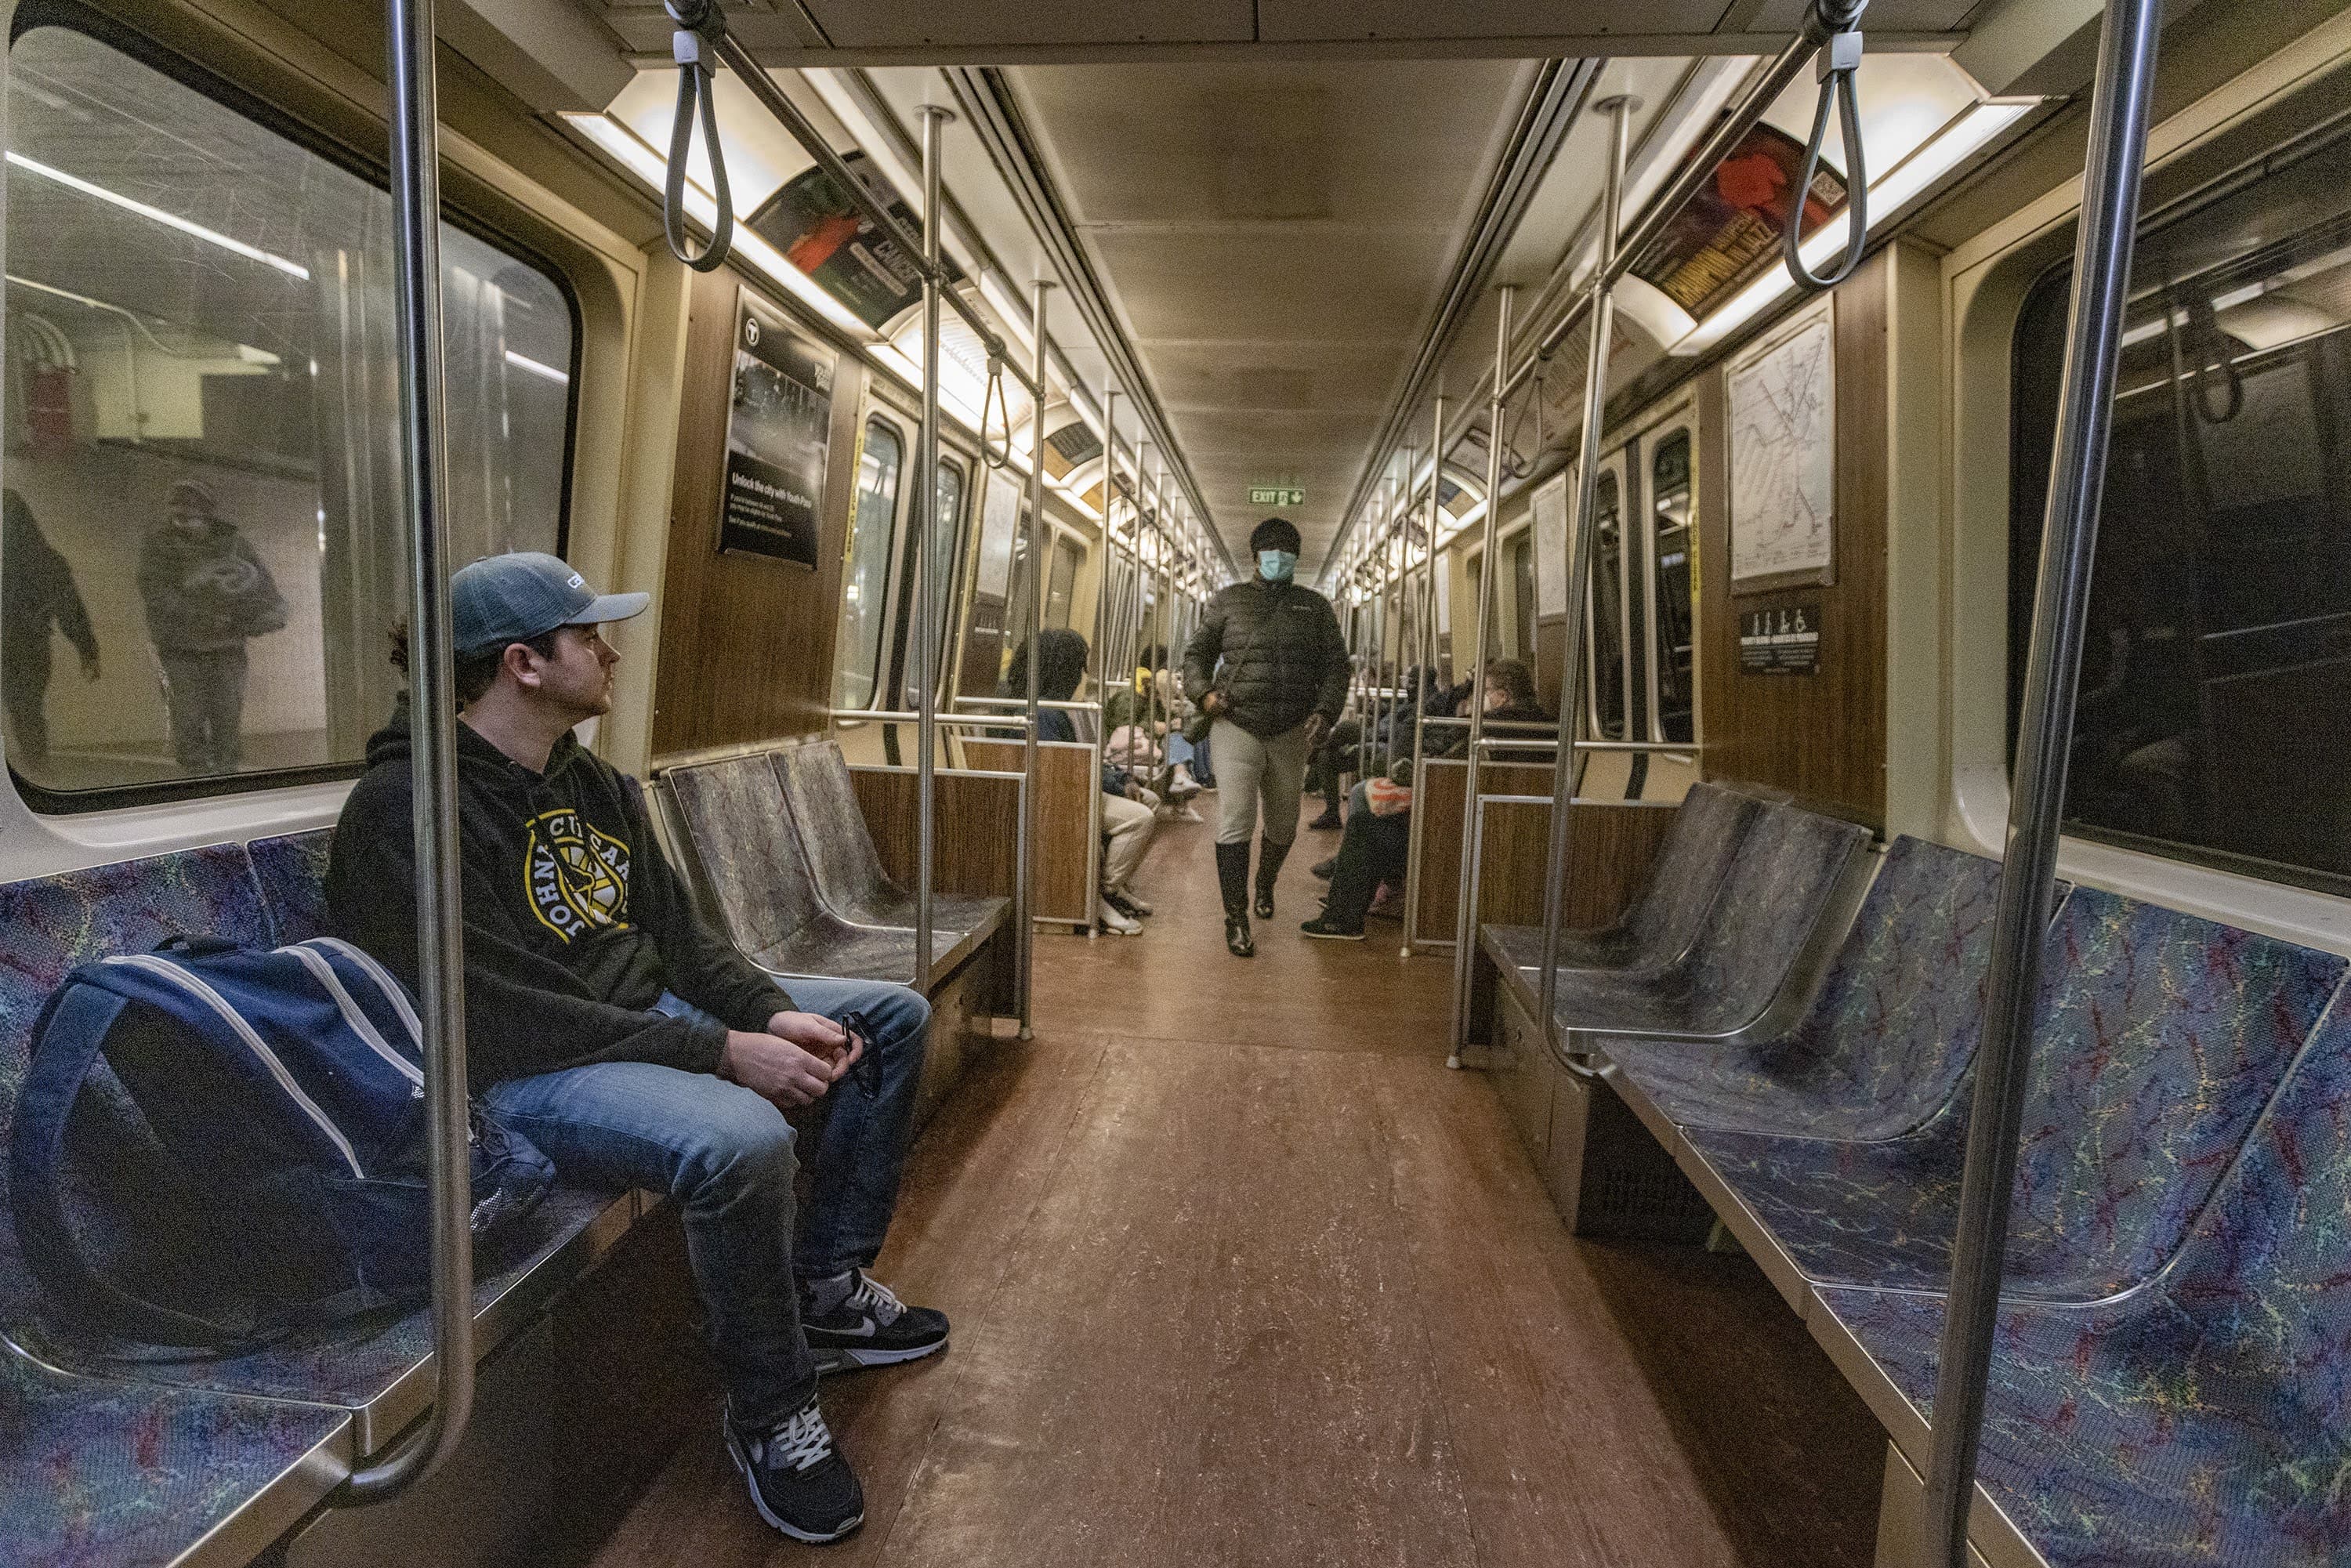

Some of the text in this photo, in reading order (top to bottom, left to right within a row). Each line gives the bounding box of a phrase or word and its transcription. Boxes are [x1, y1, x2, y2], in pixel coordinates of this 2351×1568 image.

[732, 472, 755, 489] Unlock
[754, 480, 764, 494] the
[764, 484, 775, 498] city
[774, 488, 787, 502] with
[1252, 491, 1276, 502] EXIT
